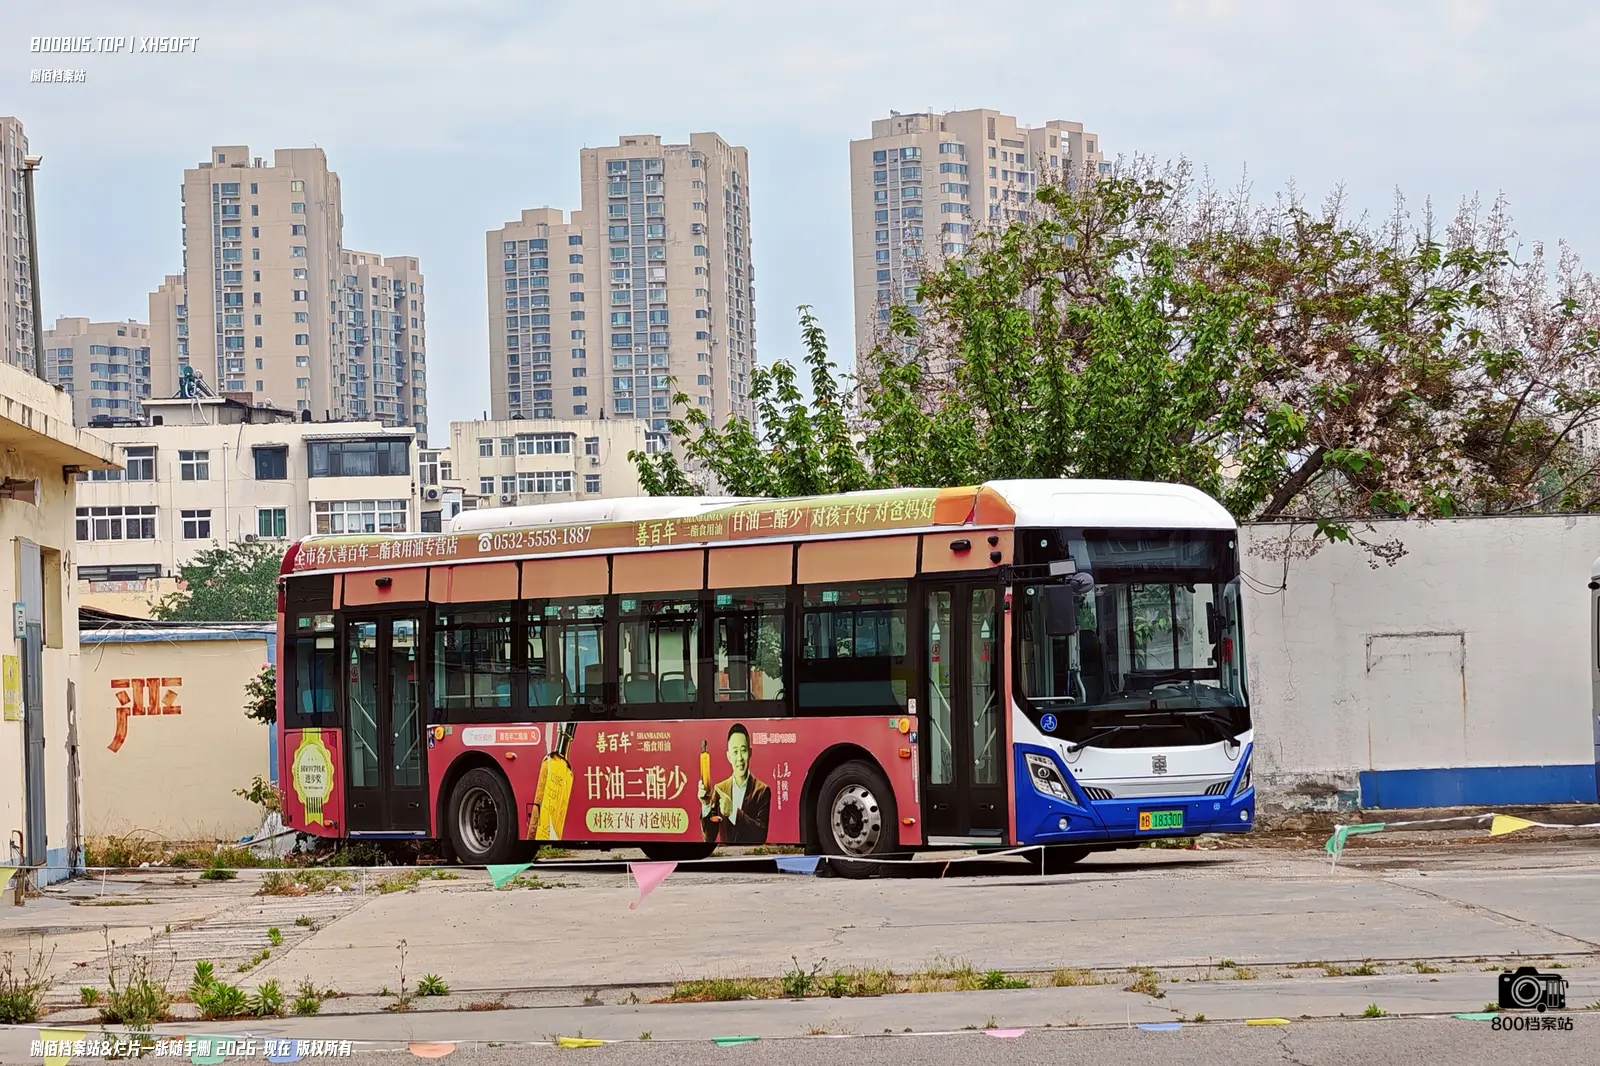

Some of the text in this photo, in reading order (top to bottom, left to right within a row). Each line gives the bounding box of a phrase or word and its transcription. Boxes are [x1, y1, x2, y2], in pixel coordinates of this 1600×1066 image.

[732, 506, 803, 532] 甘油三酯少
[810, 497, 937, 528] 对孩子好 对爸妈好
[493, 526, 592, 551] 0532-5558-1887
[635, 519, 678, 546] 善百年
[294, 536, 459, 567] 全市各大善百年二酯食用油专营店
[596, 731, 633, 754] 善百年
[584, 765, 688, 800] 甘油三酯少
[592, 812, 682, 830] 对孩子好 对爸妈好
